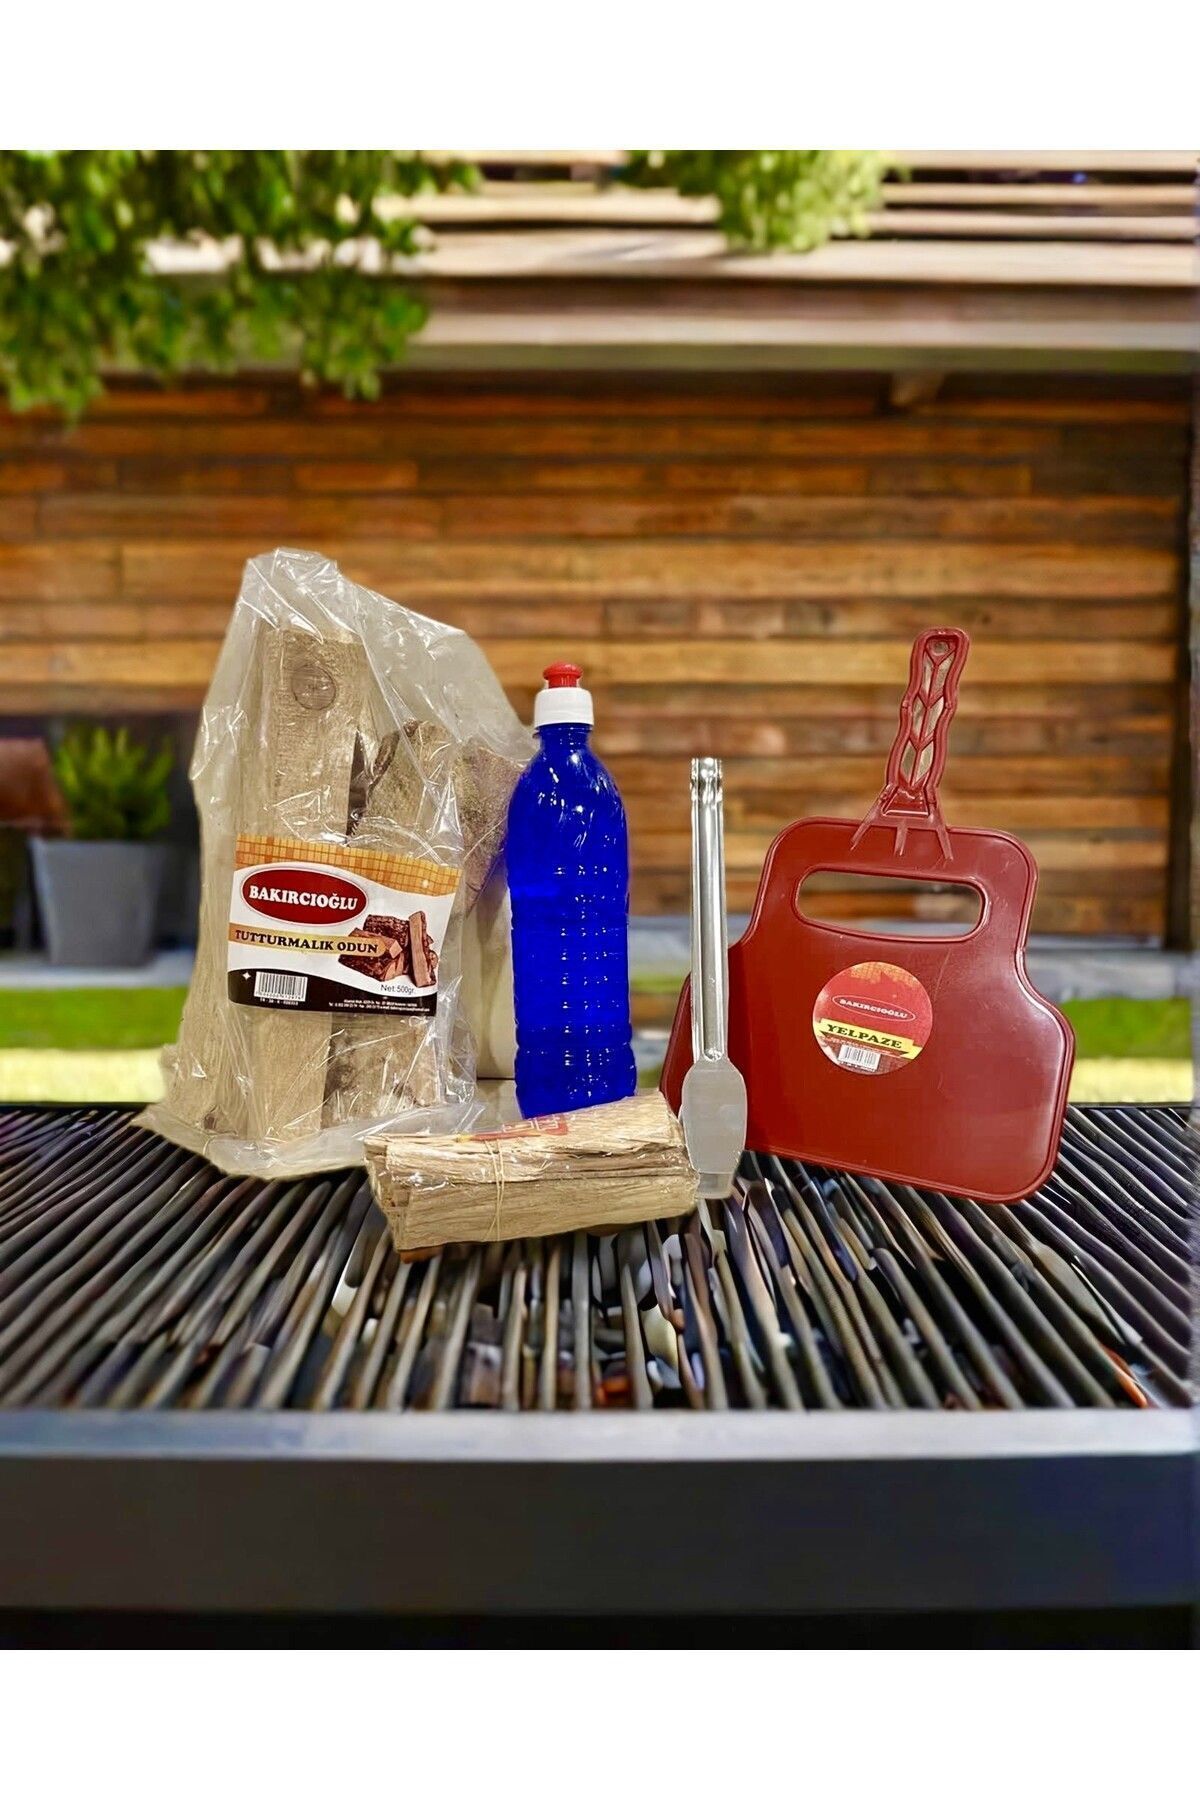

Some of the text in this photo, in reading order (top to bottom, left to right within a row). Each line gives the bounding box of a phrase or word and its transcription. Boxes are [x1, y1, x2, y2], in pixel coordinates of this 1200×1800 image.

[249, 885, 358, 911] BAKIRCIOĞLU
[235, 929, 378, 954] TUTTURMALIK ODUN
[827, 1023, 902, 1049] YELPAZE
